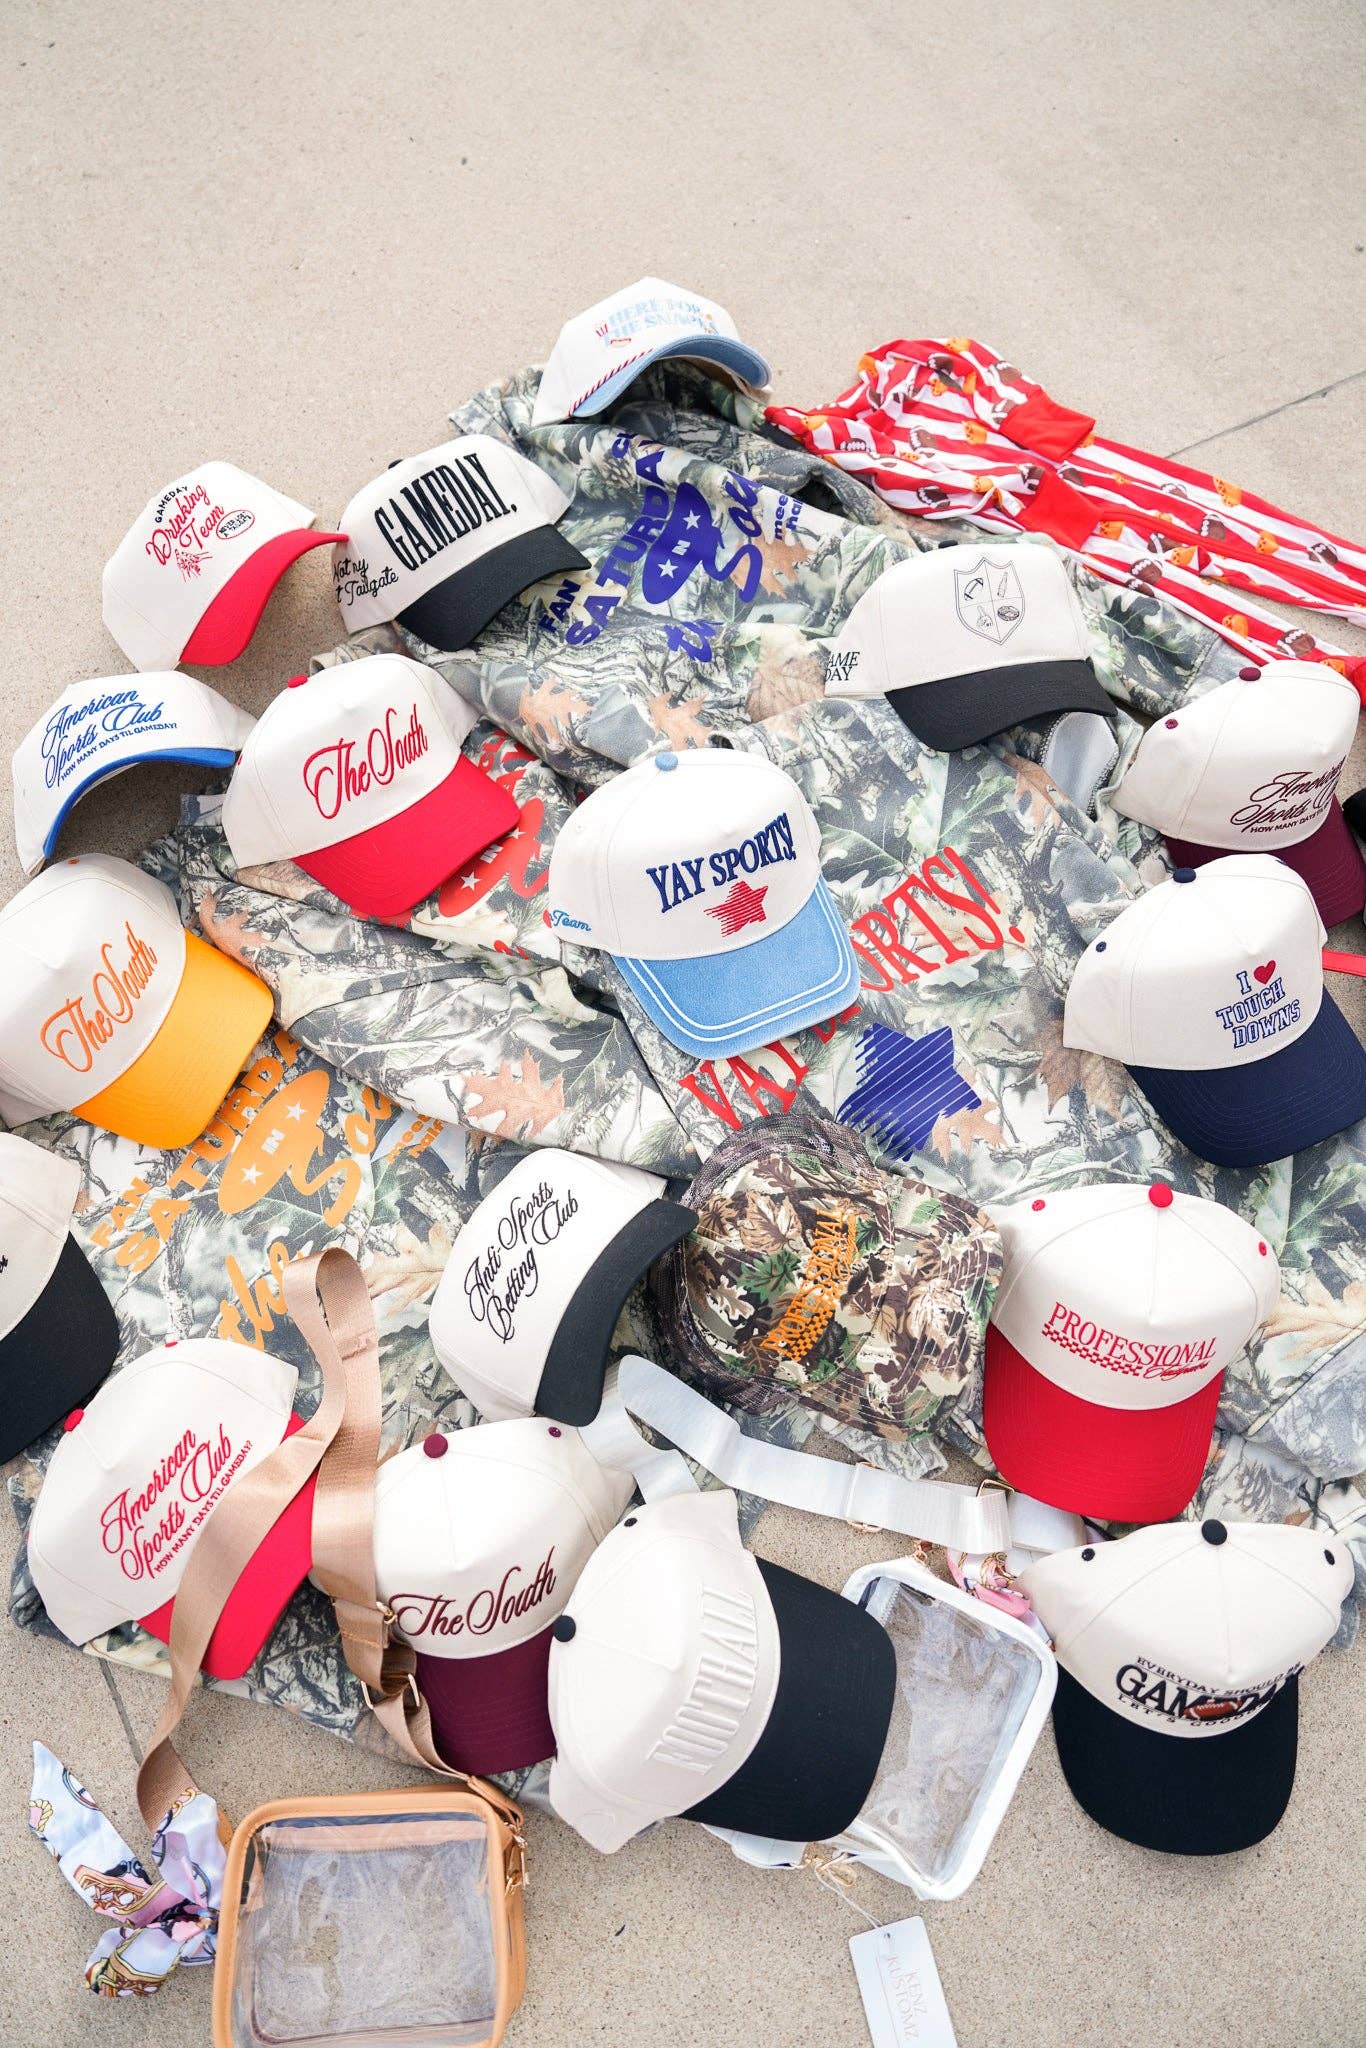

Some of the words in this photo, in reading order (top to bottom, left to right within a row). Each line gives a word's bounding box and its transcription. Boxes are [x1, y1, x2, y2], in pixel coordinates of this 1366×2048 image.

[145, 484, 210, 566] Drinking
[154, 485, 188, 523] GAMEDAY
[179, 504, 226, 550] Team
[374, 452, 518, 571] GAMEDAY.
[565, 440, 673, 645] SATURDA
[344, 566, 399, 606] Tailgate
[537, 578, 582, 633] FAN
[41, 690, 139, 758] American
[45, 724, 99, 788] Sports
[102, 701, 165, 732] Club
[60, 764, 77, 782] HOW
[76, 746, 98, 763] MANY
[99, 734, 120, 748] DAYS
[120, 728, 134, 739] TIL
[134, 721, 178, 735] GAMEDAY?
[303, 737, 371, 819] The
[368, 703, 428, 785] South
[1229, 797, 1313, 834] Sports
[1249, 826, 1274, 834] HOW
[1274, 820, 1298, 832] MANY
[645, 856, 705, 914] YAY
[552, 909, 592, 932] Team
[40, 995, 115, 1073] The
[92, 920, 158, 1024] South
[1215, 977, 1286, 1030] TOUCH
[1235, 970, 1252, 996] I
[1232, 998, 1301, 1050] DOWNS
[260, 1127, 287, 1156] IN
[90, 1177, 152, 1249] FAN
[486, 1247, 540, 1345] Betting
[531, 1189, 579, 1246] Club
[1048, 1301, 1217, 1368] PROFESSIONAL
[100, 1429, 196, 1554] American
[120, 1501, 186, 1581] Sports
[180, 1423, 232, 1503] Club
[153, 1552, 174, 1573] HOW
[173, 1526, 196, 1554] MANY
[192, 1500, 215, 1528] DAYS
[210, 1485, 224, 1503] TIL
[220, 1439, 253, 1487] GAMEDAY?
[388, 1593, 466, 1637] The
[466, 1545, 557, 1635] South
[645, 1580, 759, 1776] FOOTBALL
[1136, 1655, 1220, 1694] EVERYDAY
